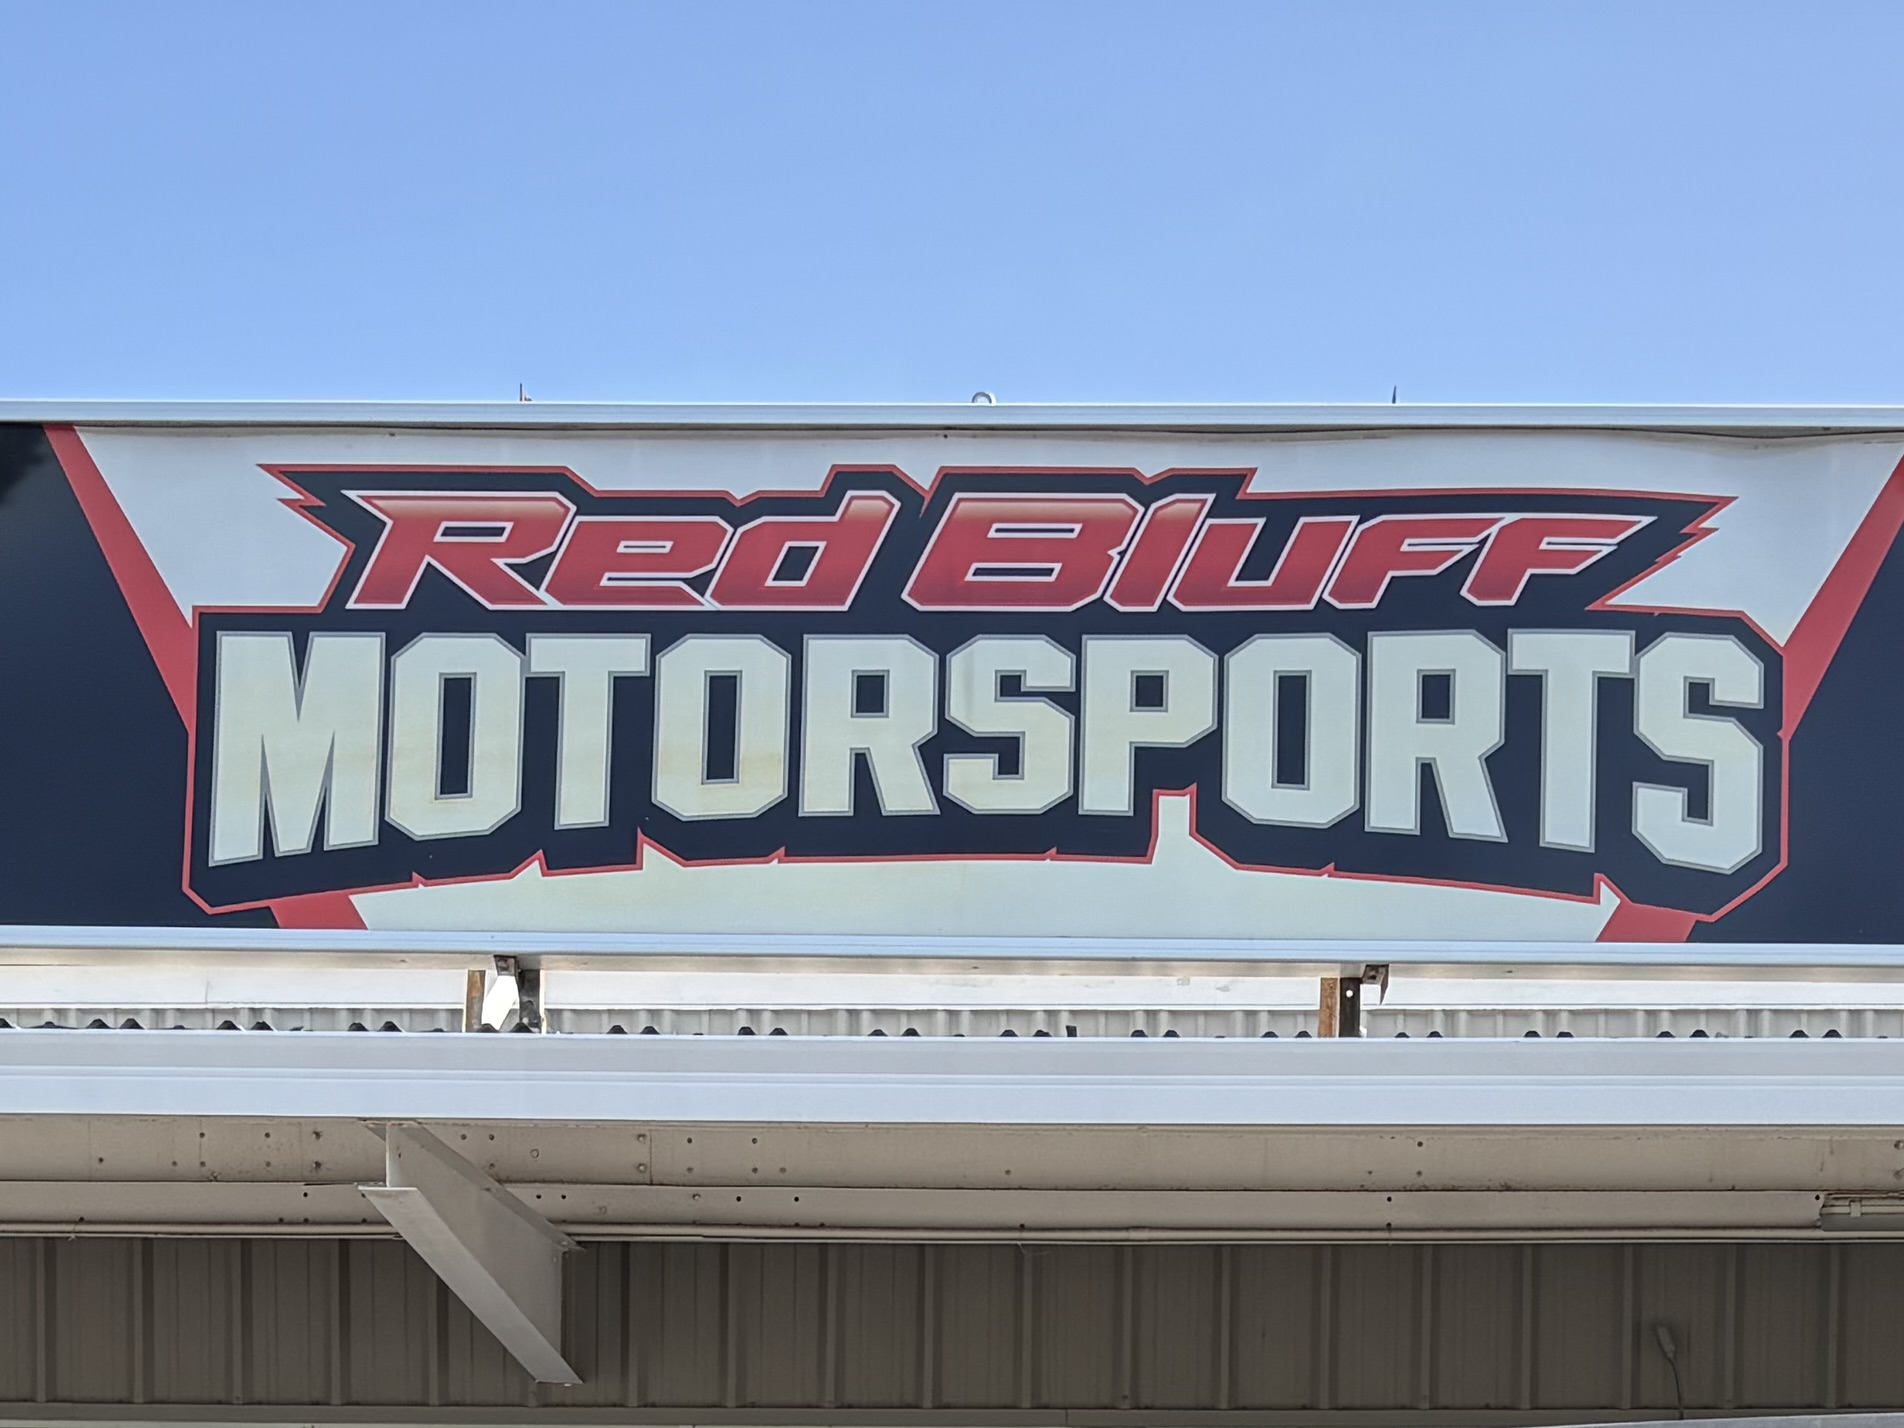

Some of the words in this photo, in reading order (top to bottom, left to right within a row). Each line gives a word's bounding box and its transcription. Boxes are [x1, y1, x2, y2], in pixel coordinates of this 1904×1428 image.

[341, 490, 901, 611] Red
[901, 492, 1658, 611] Bluff
[208, 629, 1765, 875] MOTORSPORTS
